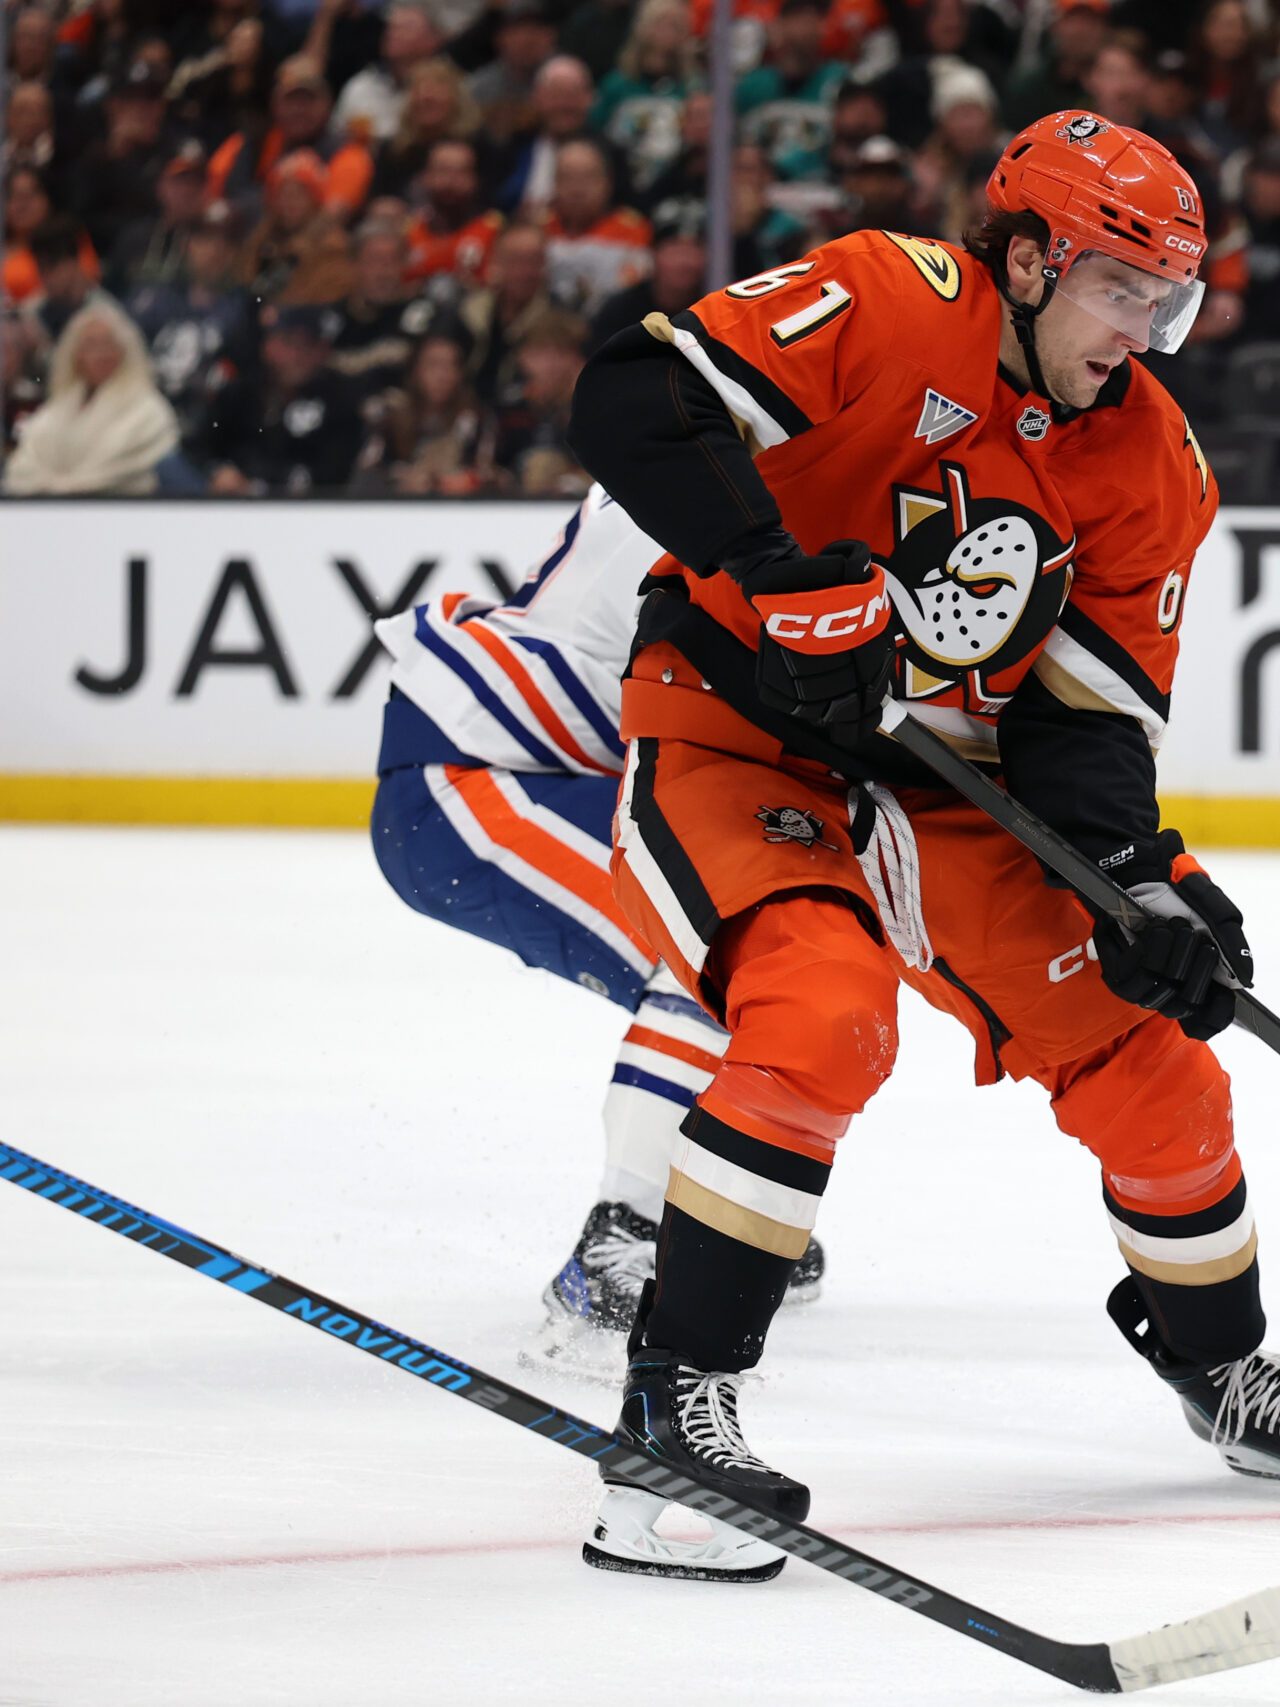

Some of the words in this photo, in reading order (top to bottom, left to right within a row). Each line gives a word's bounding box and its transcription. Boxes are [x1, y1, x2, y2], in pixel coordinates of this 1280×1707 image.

[1173, 186, 1197, 213] 61
[1165, 235, 1202, 256] CCM
[725, 262, 853, 349] 61
[1022, 420, 1044, 431] NHL
[766, 595, 890, 639] CCM
[1098, 844, 1134, 867] CCM
[284, 1296, 473, 1392] NOVIUM
[465, 1385, 511, 1410] 2
[610, 1454, 934, 1609] WARRIOR
